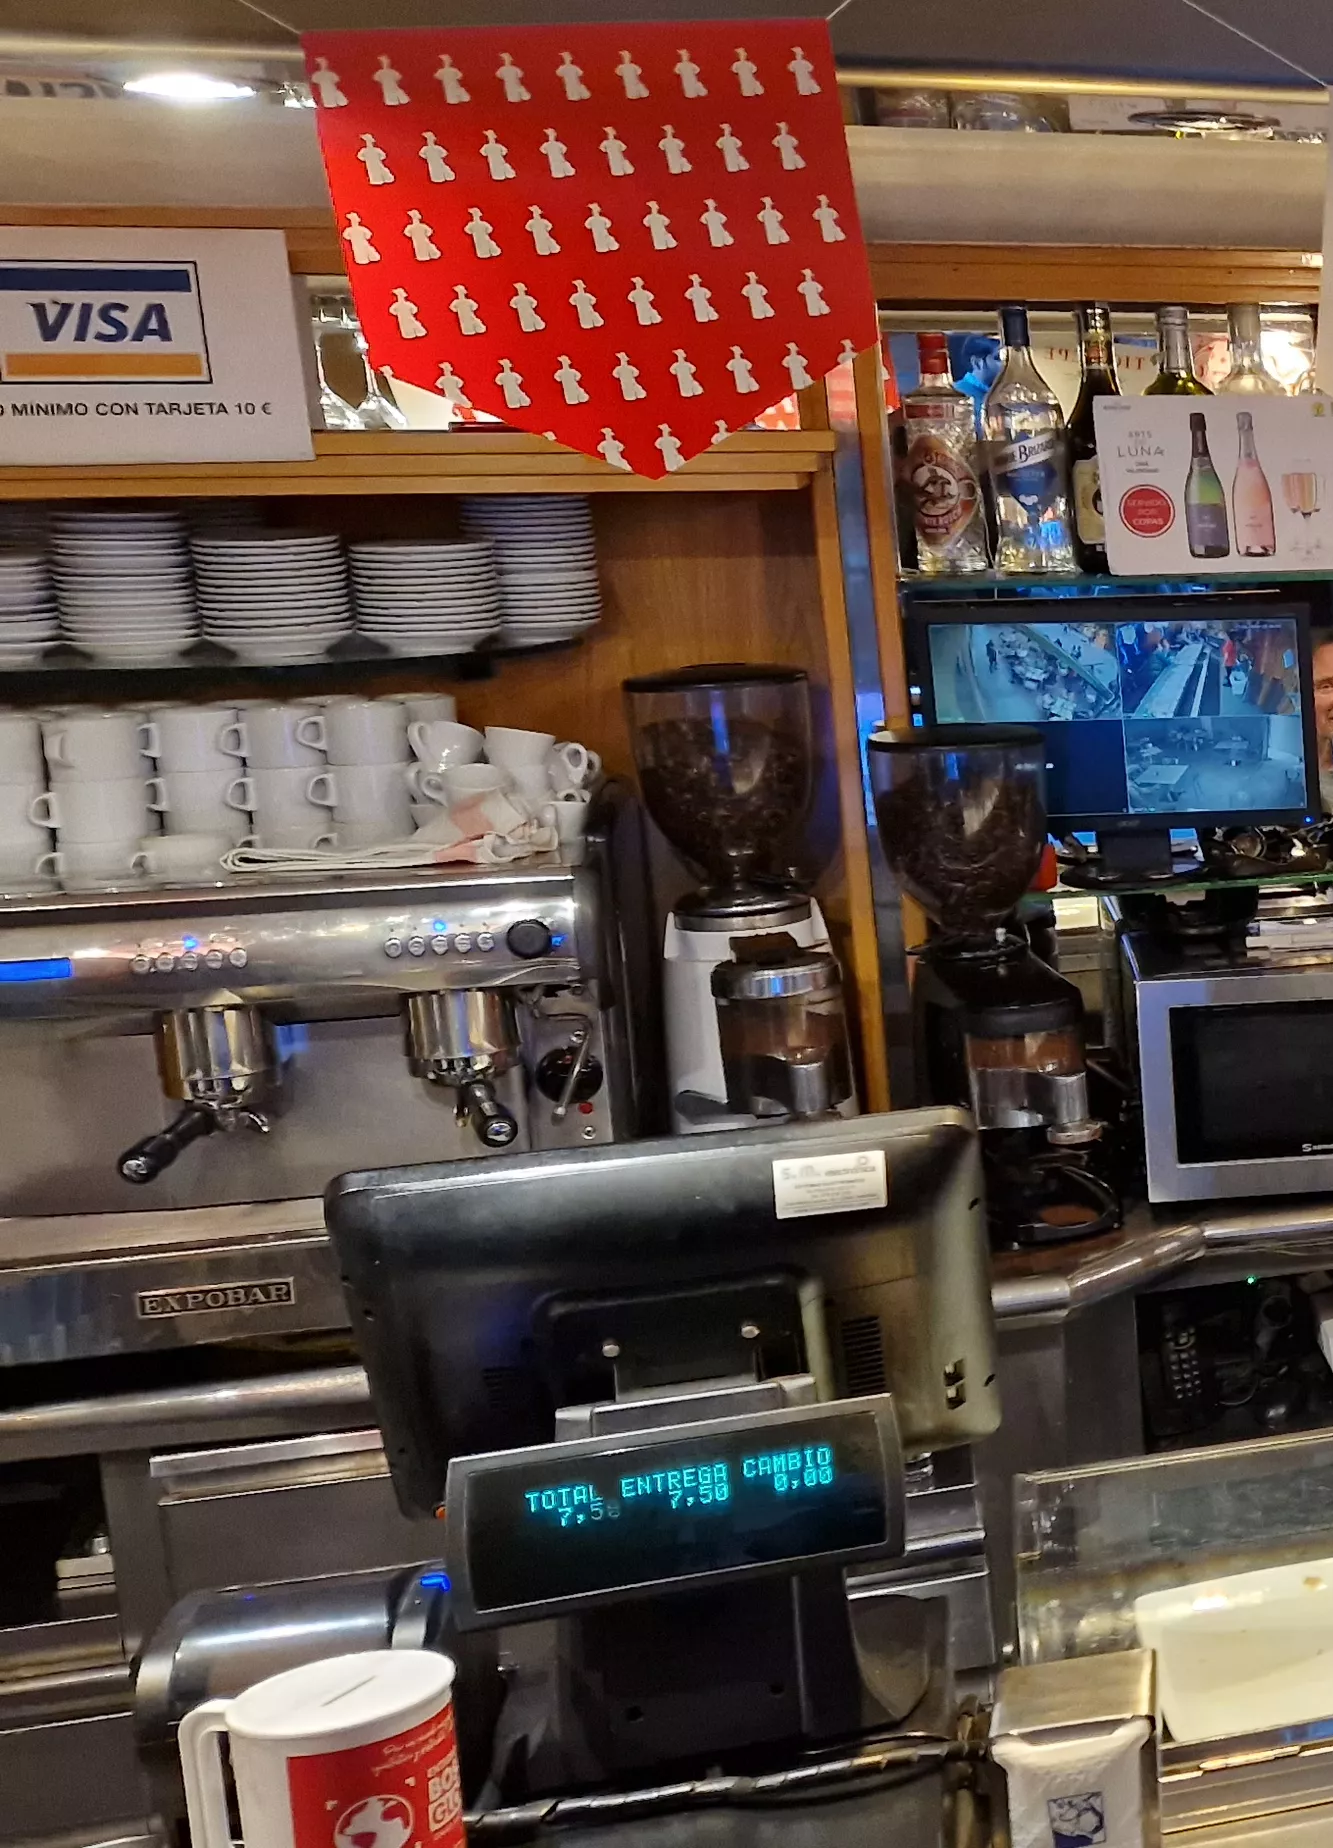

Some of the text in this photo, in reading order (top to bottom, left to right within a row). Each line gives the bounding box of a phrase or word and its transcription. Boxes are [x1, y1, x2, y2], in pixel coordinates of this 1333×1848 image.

[27, 301, 173, 342] VISA
[96, 403, 139, 416] CON
[144, 402, 229, 416] TARJETA
[234, 402, 256, 415] 10
[261, 402, 272, 415] €
[1117, 445, 1165, 458] LUNA
[142, 1284, 290, 1314] EXPOBAR
[525, 1447, 831, 1512] TOTAL ENTREGA CAMBIO
[668, 1484, 729, 1509] 7,50
[773, 1466, 833, 1492] 0,00
